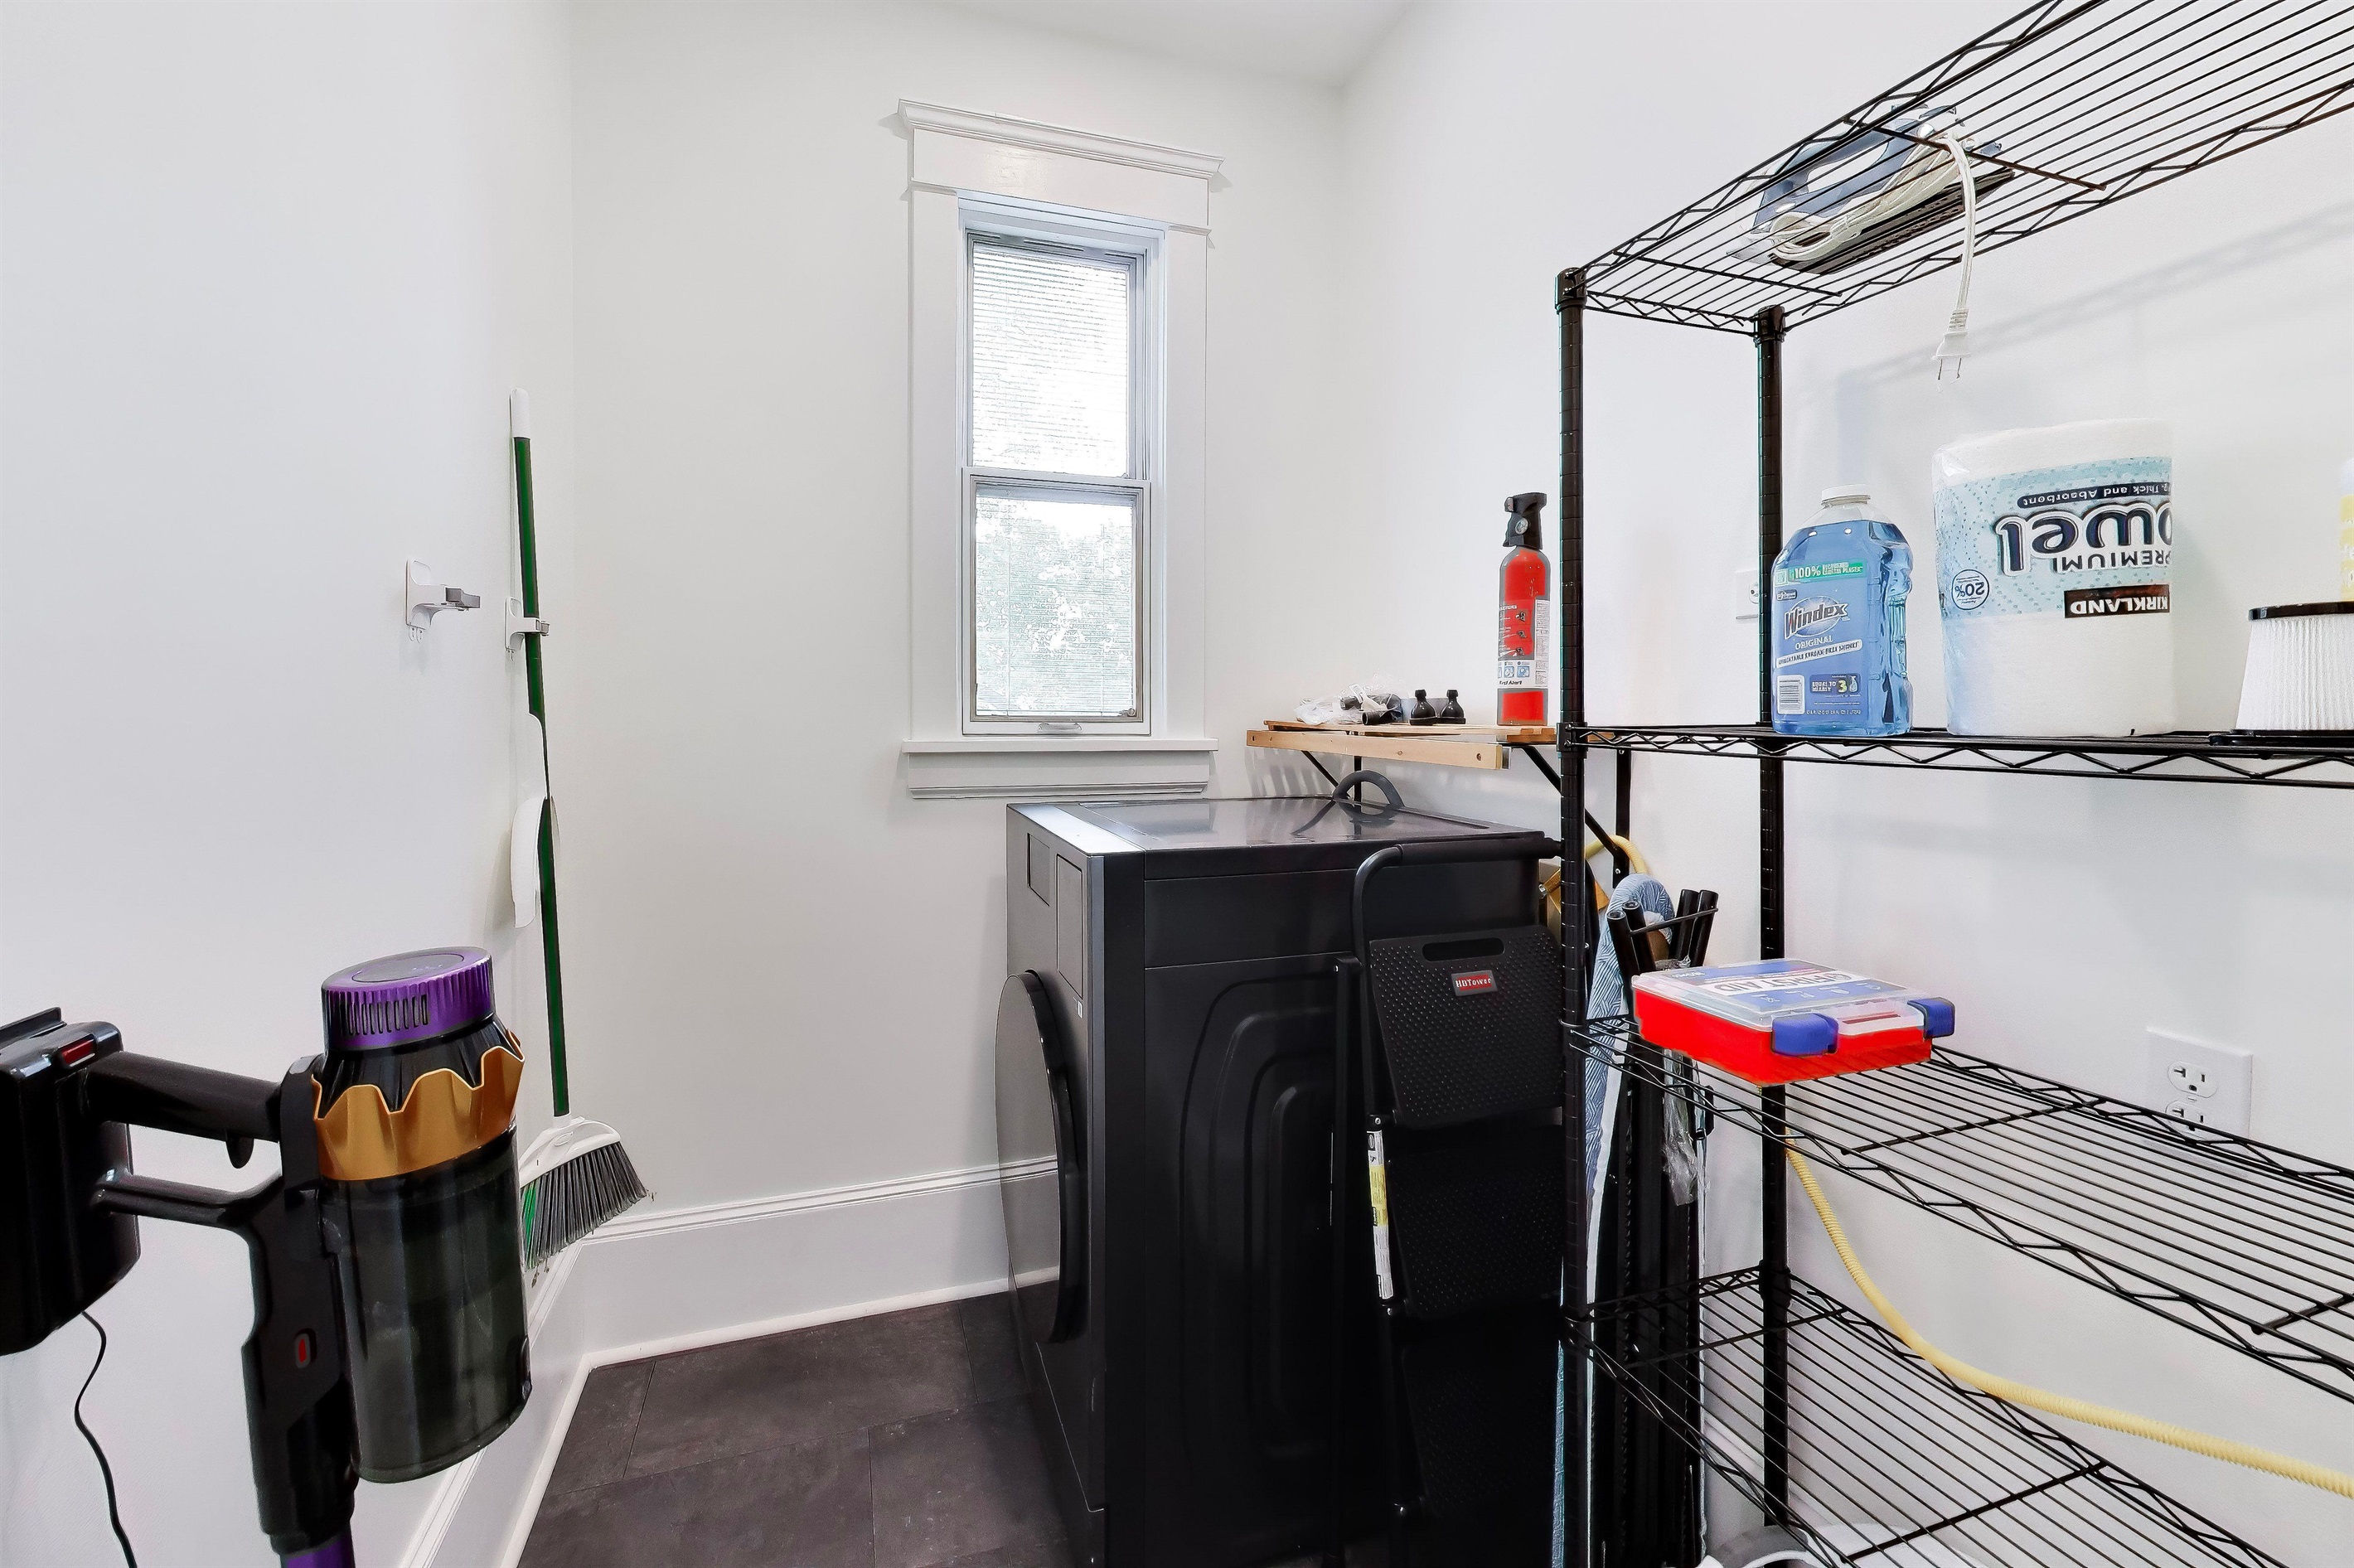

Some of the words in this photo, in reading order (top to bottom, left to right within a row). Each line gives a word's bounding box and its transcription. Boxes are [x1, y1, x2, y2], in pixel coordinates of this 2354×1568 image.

[2104, 486, 2128, 497] and
[1795, 564, 1821, 578] 100%
[1954, 581, 1985, 598] 20%
[2070, 595, 2168, 615] KIRKLAND
[1784, 603, 1848, 640] Windex
[1795, 635, 1833, 651] ORIGINAL
[1838, 679, 1848, 694] 3
[1713, 980, 1762, 992] AID
[1761, 972, 1835, 990] FIRST
